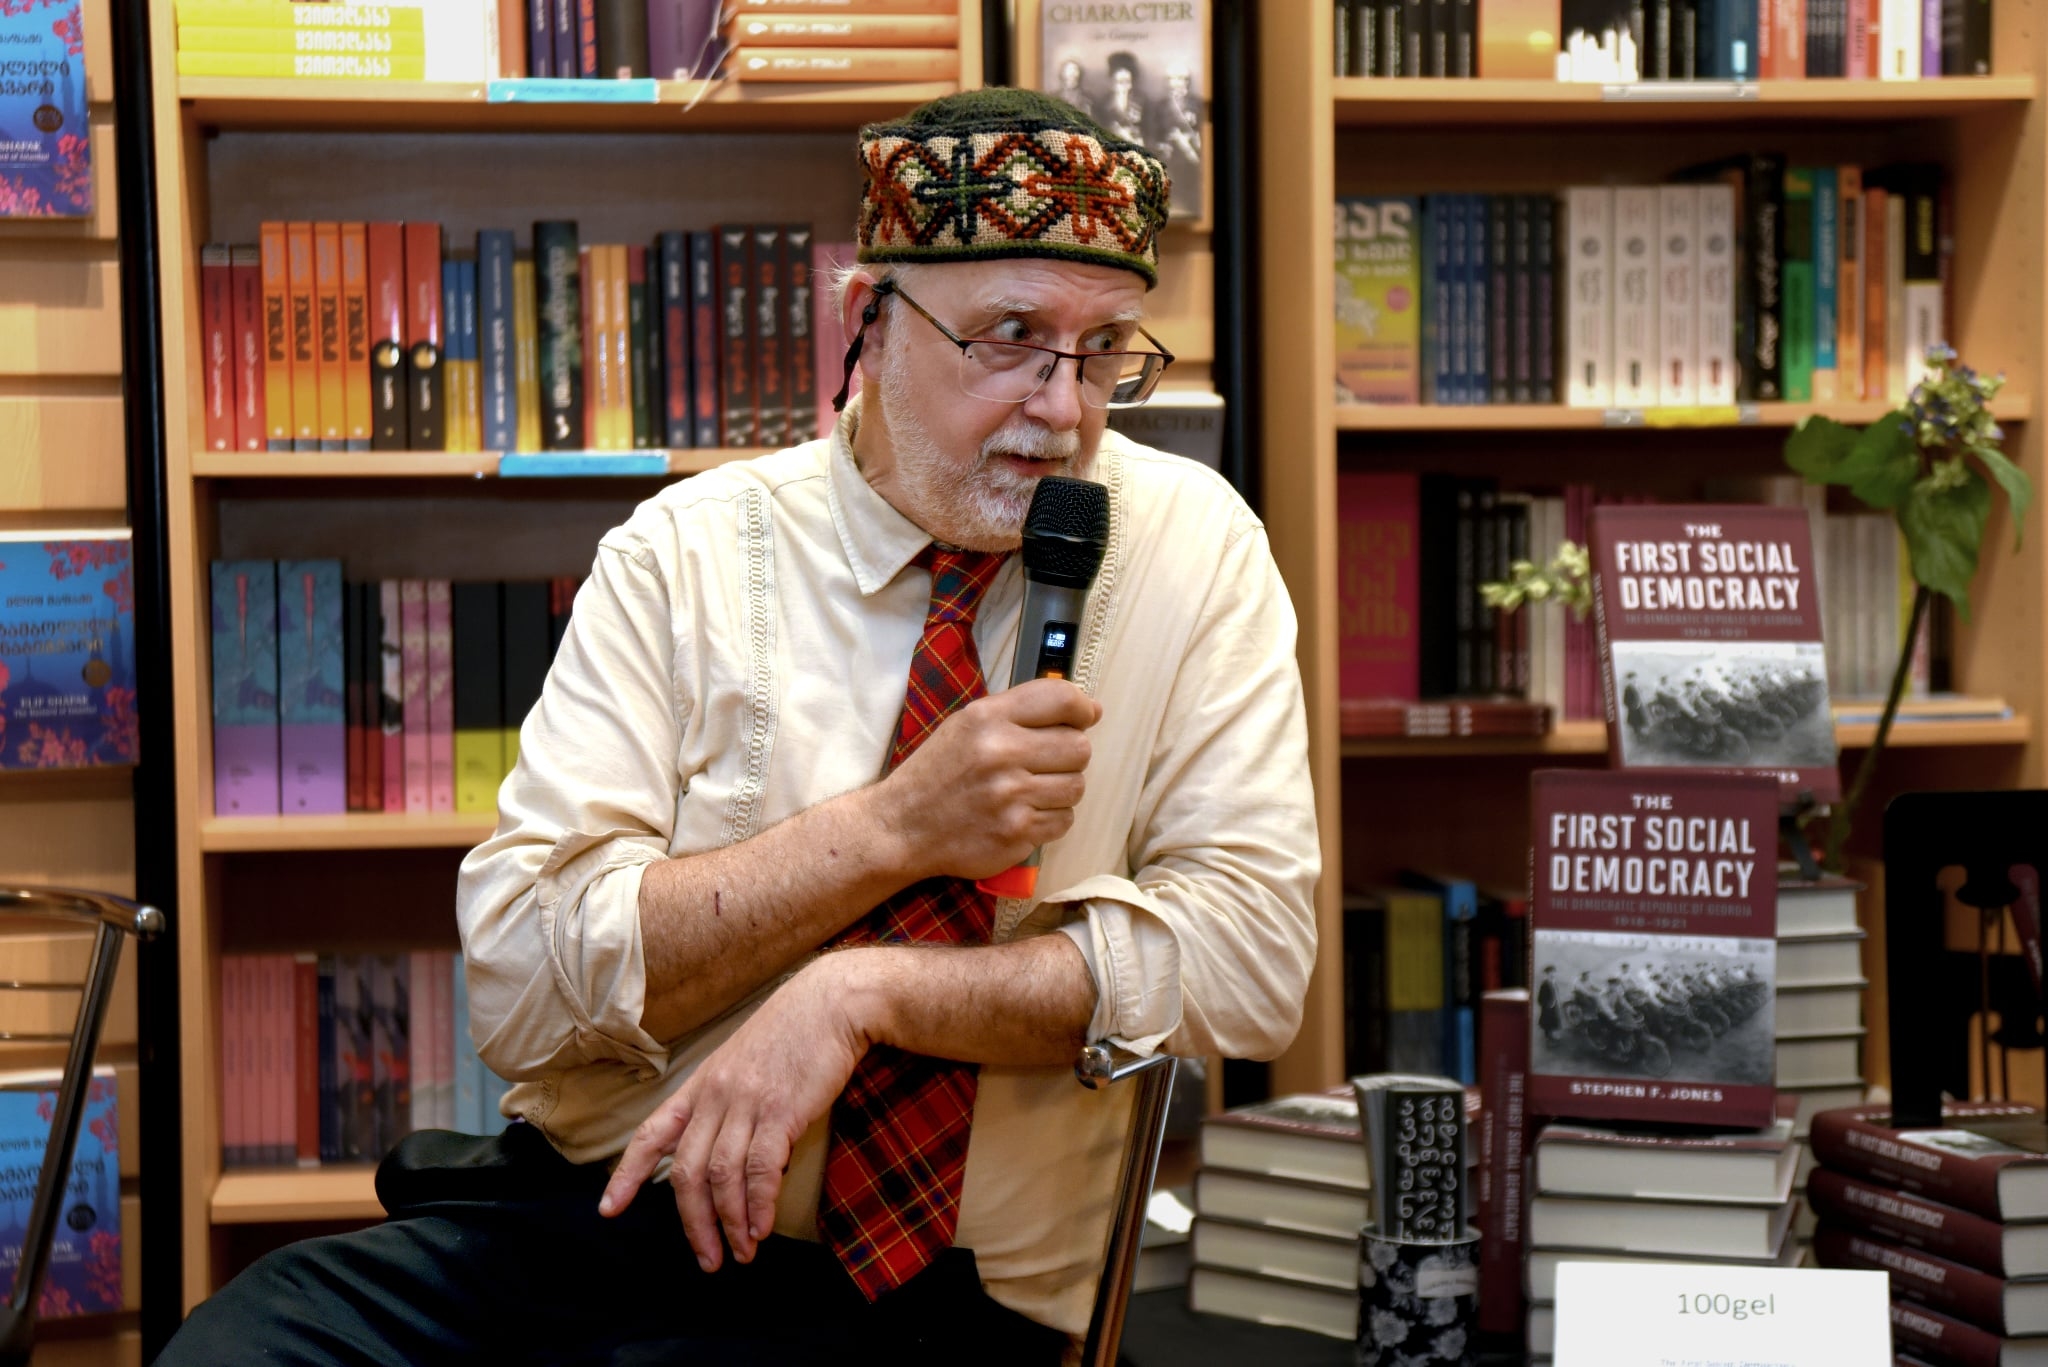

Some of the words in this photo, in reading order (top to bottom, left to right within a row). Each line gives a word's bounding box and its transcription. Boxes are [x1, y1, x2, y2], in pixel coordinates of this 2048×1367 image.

[1050, 2, 1193, 24] CHARACTER
[1684, 523, 1723, 538] THE
[1615, 541, 1692, 573] FIRST
[1699, 542, 1800, 574] SOCIAL
[1619, 576, 1801, 611] DEMOCRACY
[1631, 794, 1673, 810] THE
[1550, 813, 1637, 851] FIRST
[1644, 816, 1757, 855] SOCIAL
[1550, 854, 1756, 899] DEMOCRACY
[1569, 1082, 1646, 1098] STEPHEN
[1650, 1086, 1666, 1099] F.
[1670, 1087, 1724, 1102] JONES
[1678, 1293, 1775, 1320] 100gel
